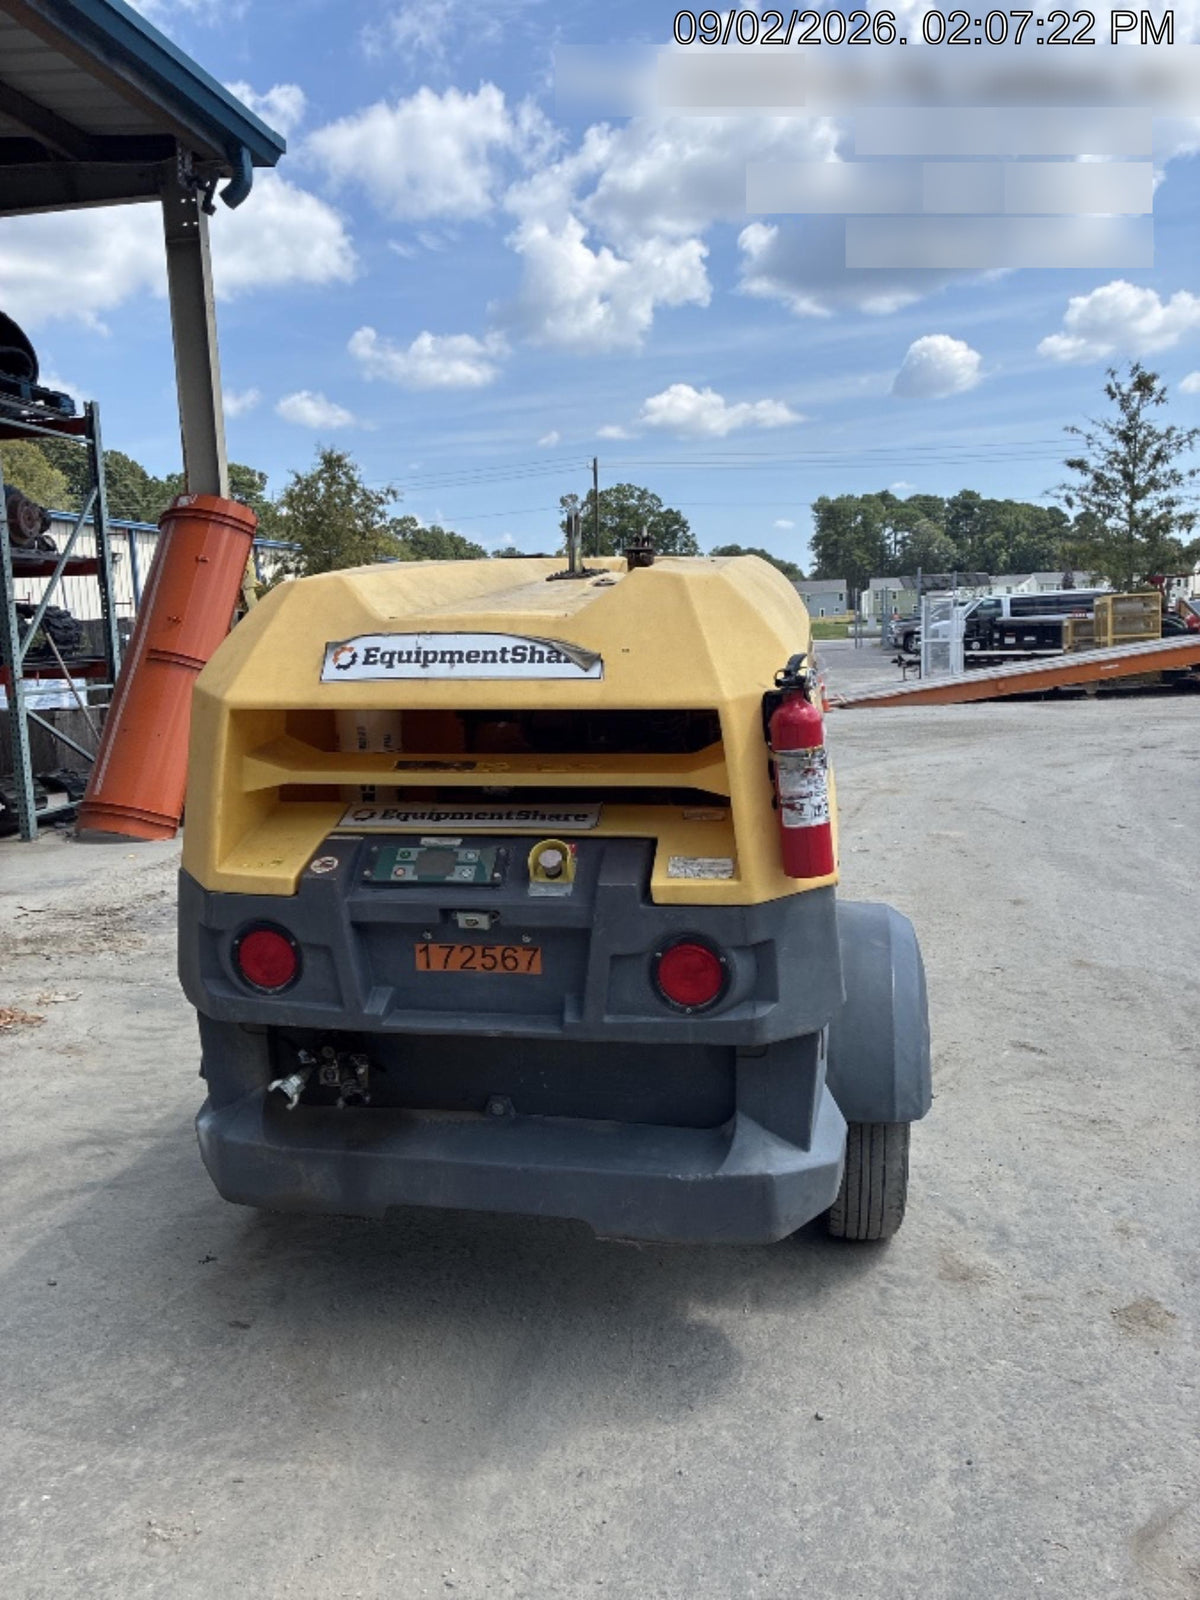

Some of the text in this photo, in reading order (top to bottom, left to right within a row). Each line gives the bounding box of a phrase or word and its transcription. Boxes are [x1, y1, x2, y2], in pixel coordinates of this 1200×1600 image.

[362, 646, 575, 669] EquipmentSha
[379, 808, 588, 822] EquipmentShare
[418, 944, 539, 972] 172567
